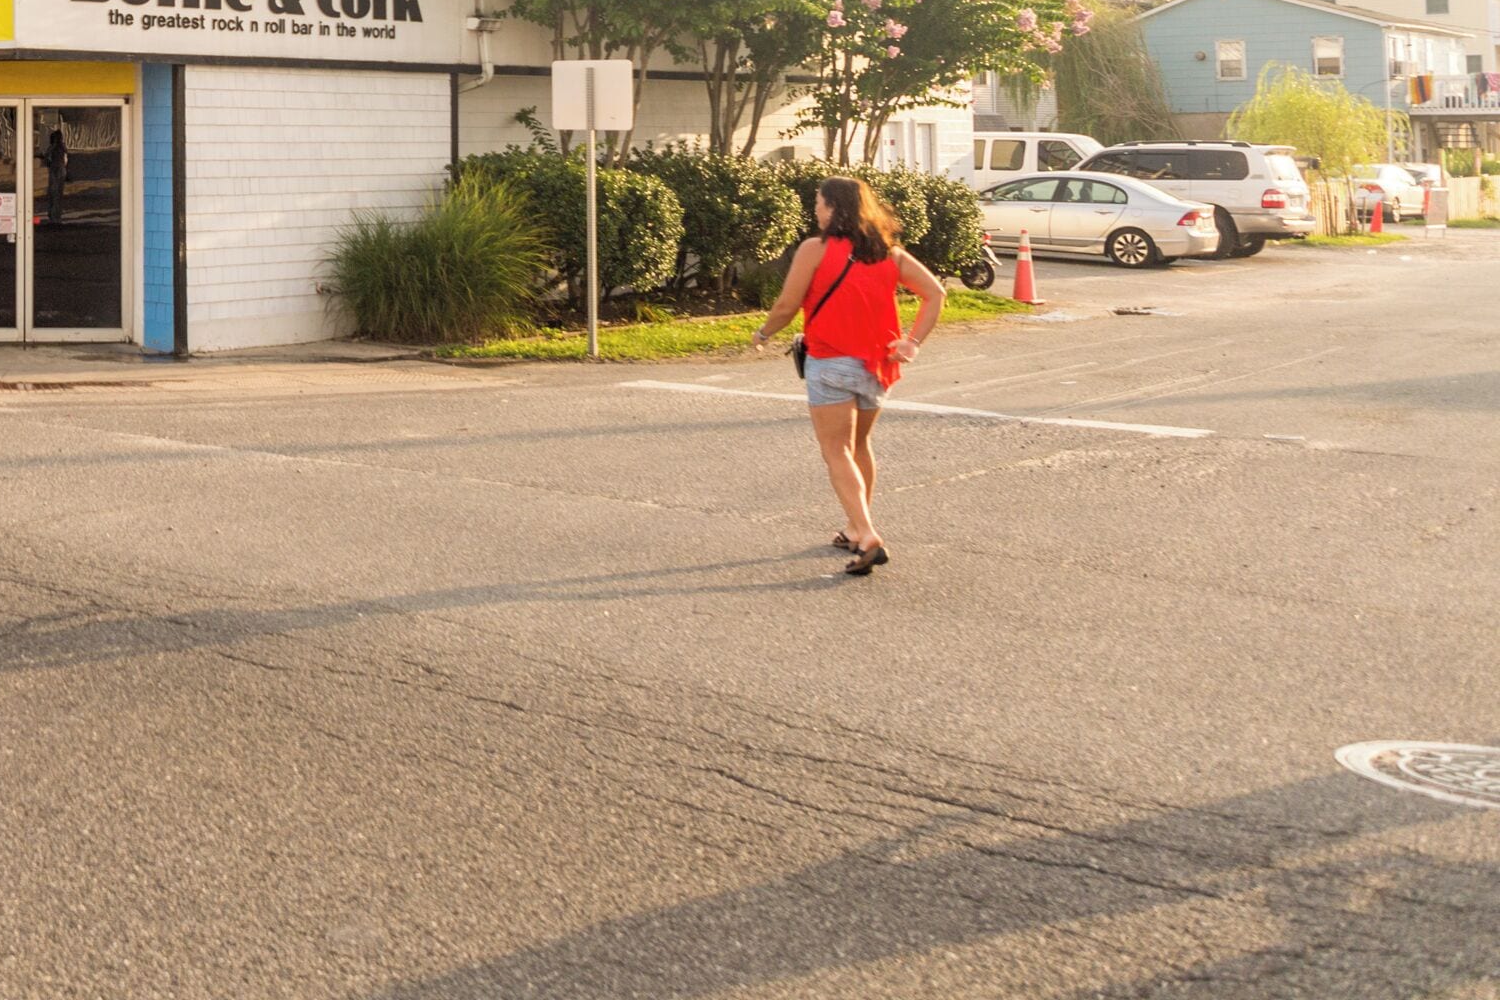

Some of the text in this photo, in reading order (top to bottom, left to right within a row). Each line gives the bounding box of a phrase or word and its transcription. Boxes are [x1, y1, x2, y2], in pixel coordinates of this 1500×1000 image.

[108, 9, 396, 40] the greatest rock n roll bar in the world
